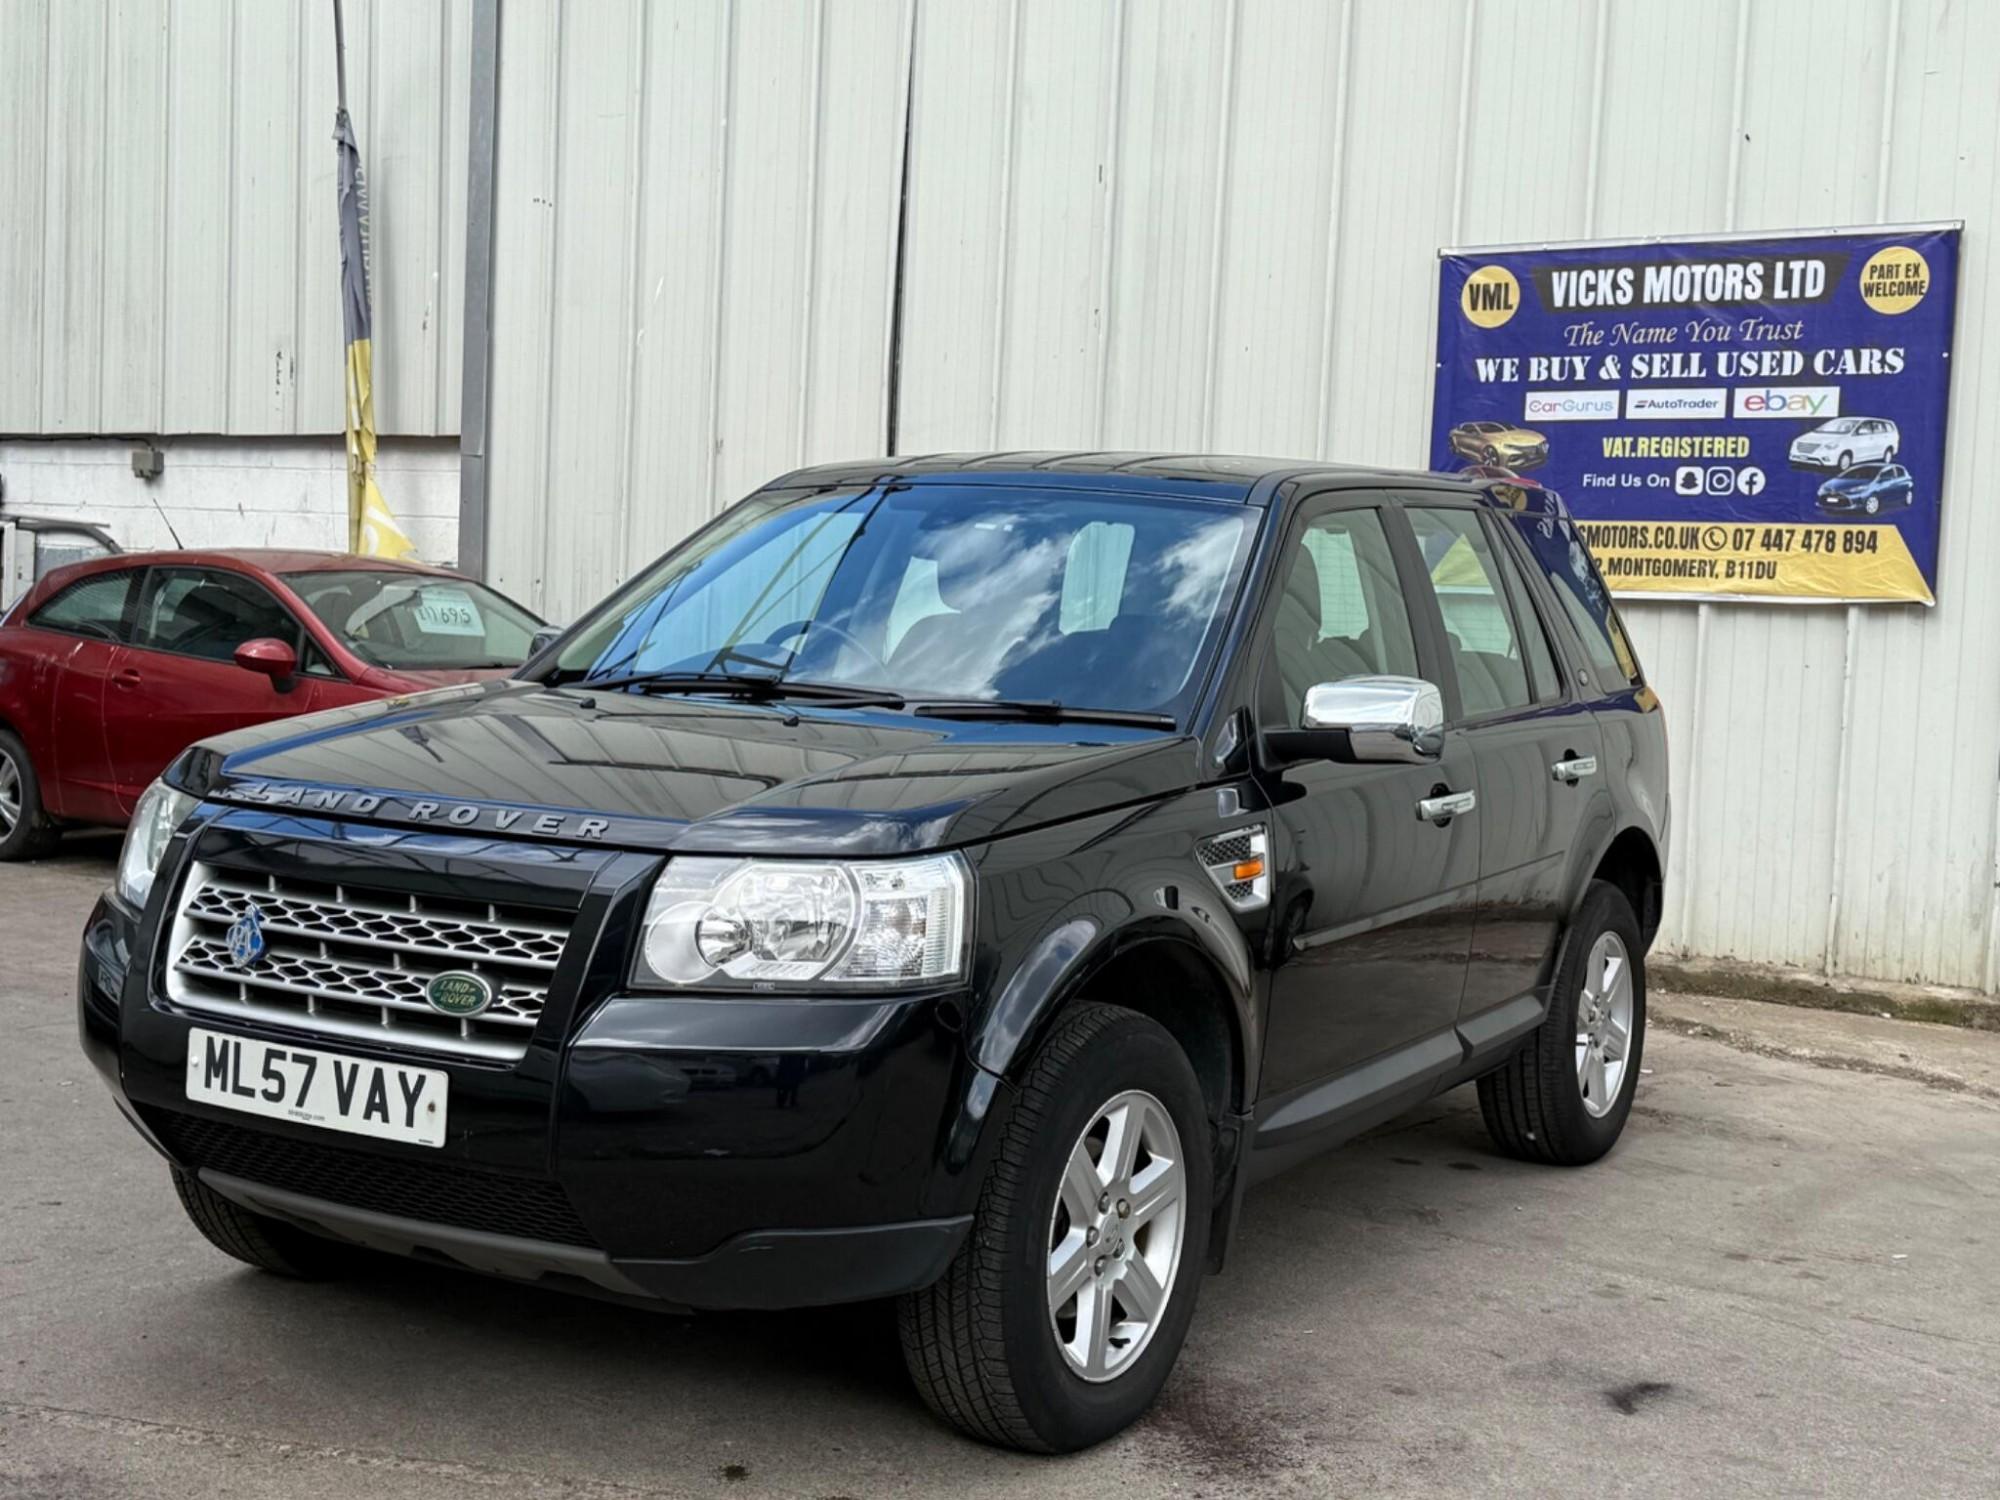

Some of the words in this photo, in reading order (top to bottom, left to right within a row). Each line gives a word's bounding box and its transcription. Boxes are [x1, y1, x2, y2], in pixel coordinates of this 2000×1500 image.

[1552, 267, 1633, 307] VICKS
[1643, 263, 1763, 304] MOTORS
[1774, 260, 1826, 300] LTD
[1870, 263, 1901, 281] PART
[1904, 262, 1921, 279] EX
[1469, 282, 1514, 312] VML
[1863, 279, 1927, 298] WELCOME
[1564, 322, 1604, 347] The
[1608, 322, 1678, 347] Name
[1685, 320, 1730, 344] You
[1739, 317, 1803, 342] Trust
[1475, 358, 1519, 382] WE
[1528, 355, 1591, 382] BUY
[1598, 354, 1621, 380] &
[1631, 351, 1707, 379] SELL
[1717, 350, 1804, 378] USED
[1813, 347, 1905, 376] CARS
[1528, 398, 1614, 413] CarGurus
[1648, 397, 1719, 410] AutoTrader
[1744, 390, 1827, 415] ebay
[1602, 436, 1750, 458] VAT.REGISTERED
[1582, 473, 1616, 488] Find
[1621, 473, 1642, 487] Us
[1647, 473, 1670, 487] On
[1732, 528, 1756, 552] 07
[1760, 529, 1795, 552] 447
[1799, 529, 1836, 553] 478
[1842, 530, 1878, 554] 894
[1725, 560, 1778, 581] B11DU
[256, 782, 382, 817] LAND
[409, 802, 608, 838] ROVER
[204, 1036, 318, 1108] ML57
[333, 1060, 427, 1128] VAY
